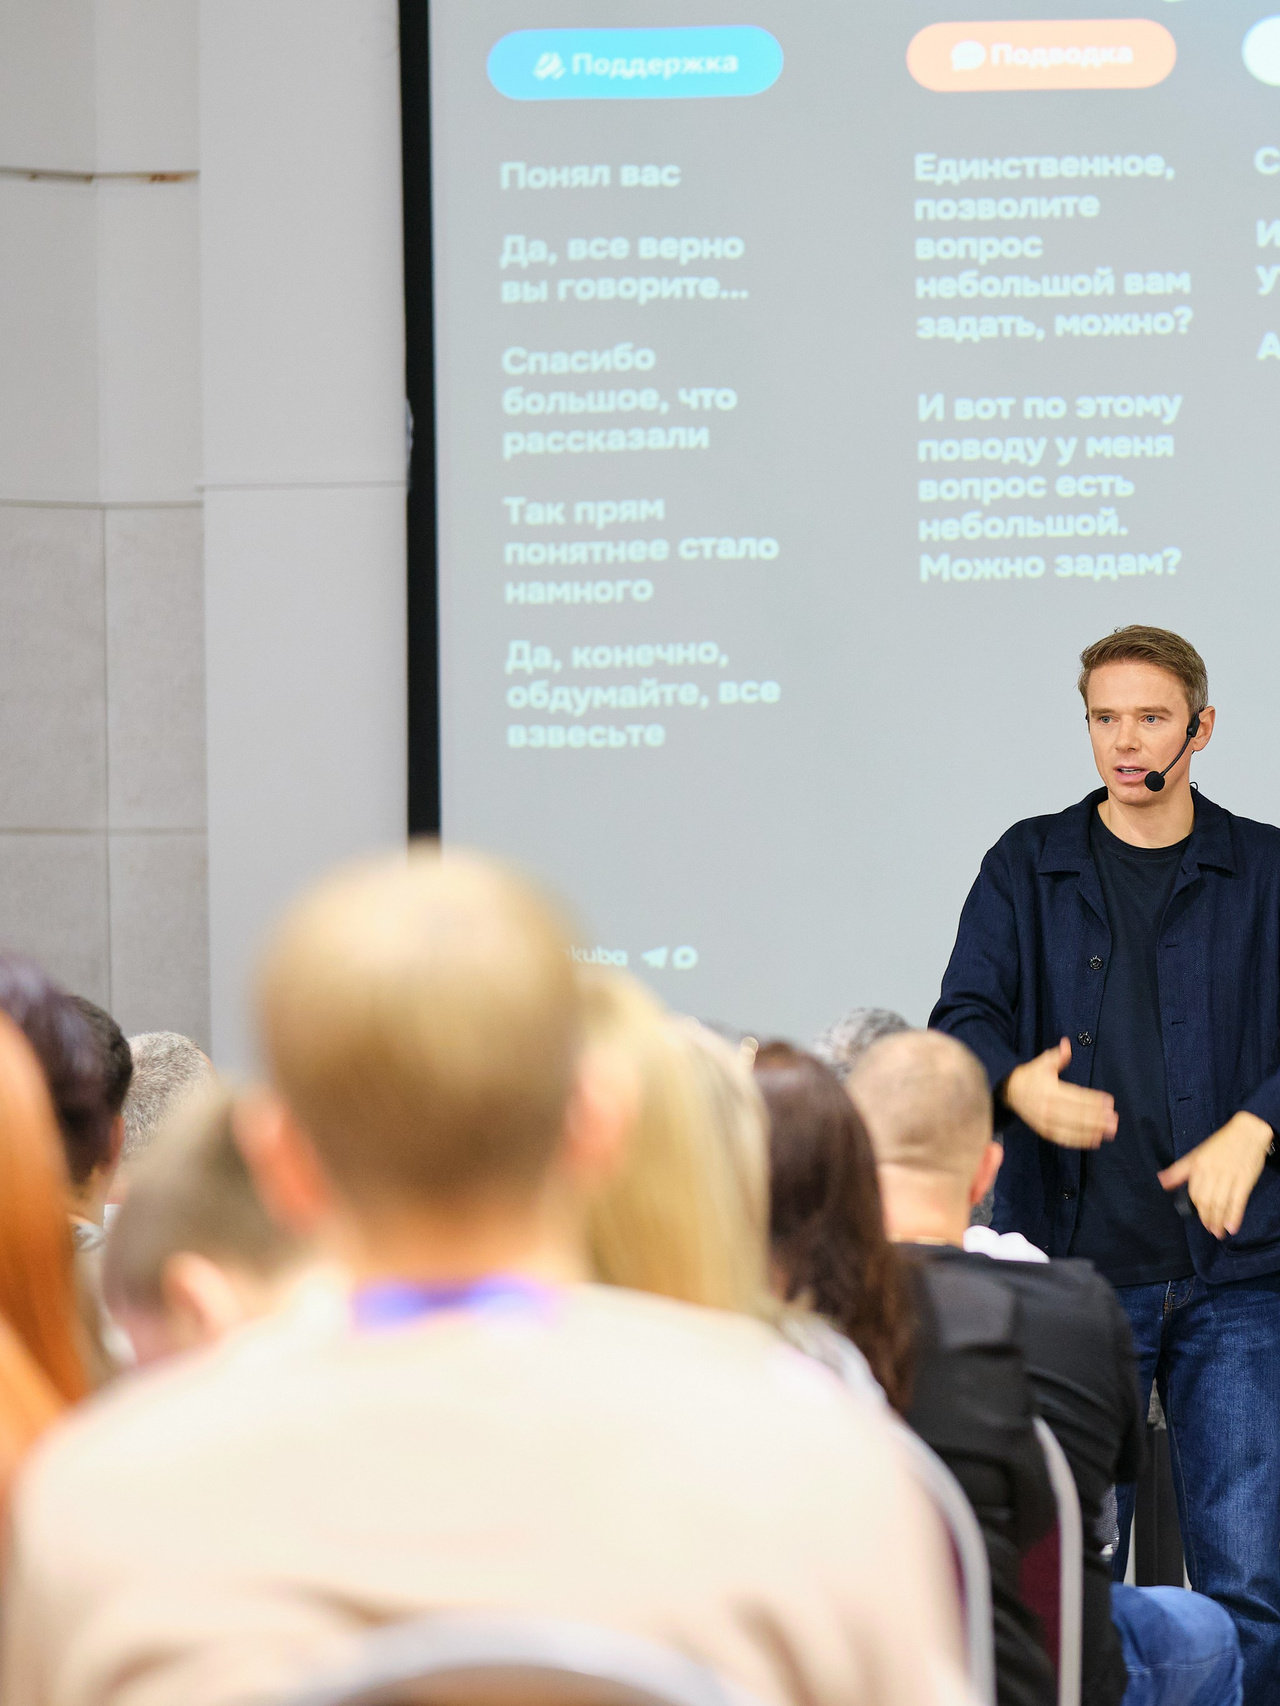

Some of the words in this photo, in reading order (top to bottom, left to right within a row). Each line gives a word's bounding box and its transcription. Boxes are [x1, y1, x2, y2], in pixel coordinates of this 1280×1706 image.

[571, 53, 739, 79] Поддержка
[990, 43, 1133, 68] Подводка
[500, 161, 611, 190] Понял
[620, 164, 681, 187] вас
[914, 153, 1175, 186] Единственное,
[914, 195, 1100, 221] позволите
[499, 234, 558, 269] Да,
[567, 237, 630, 261] все
[638, 237, 745, 266] верно
[915, 236, 1043, 265] вопрос
[501, 280, 548, 304] вы
[557, 276, 749, 305] говорите...
[915, 267, 1115, 299] небольшой
[1123, 272, 1191, 295] вам
[916, 315, 1045, 343] задать,
[1054, 306, 1193, 337] можно?
[502, 342, 656, 375] Спасибо
[502, 386, 669, 415] большое,
[678, 388, 738, 411] что
[918, 393, 945, 422] И
[954, 397, 1016, 421] вот
[1023, 397, 1067, 419] по
[1075, 395, 1183, 425] этому
[503, 427, 710, 461] рассказали
[917, 437, 1047, 467] поводу
[1055, 437, 1078, 467] у
[1086, 435, 1175, 458] меня
[918, 476, 1046, 506] вопрос
[1056, 475, 1135, 498] есть
[503, 496, 565, 525] Так
[574, 498, 665, 530] прям
[918, 507, 1128, 542] небольшой.
[504, 539, 670, 565] понятнее
[678, 537, 780, 560] стало
[920, 553, 1046, 582] Можно
[1054, 547, 1182, 581] задам?
[505, 579, 654, 604] намного
[505, 640, 562, 675] Да,
[572, 641, 729, 668] конечно,
[506, 678, 709, 717] обдумайте,
[718, 681, 781, 704] все
[507, 724, 666, 749] взвесьте
[565, 945, 629, 967] kuba
